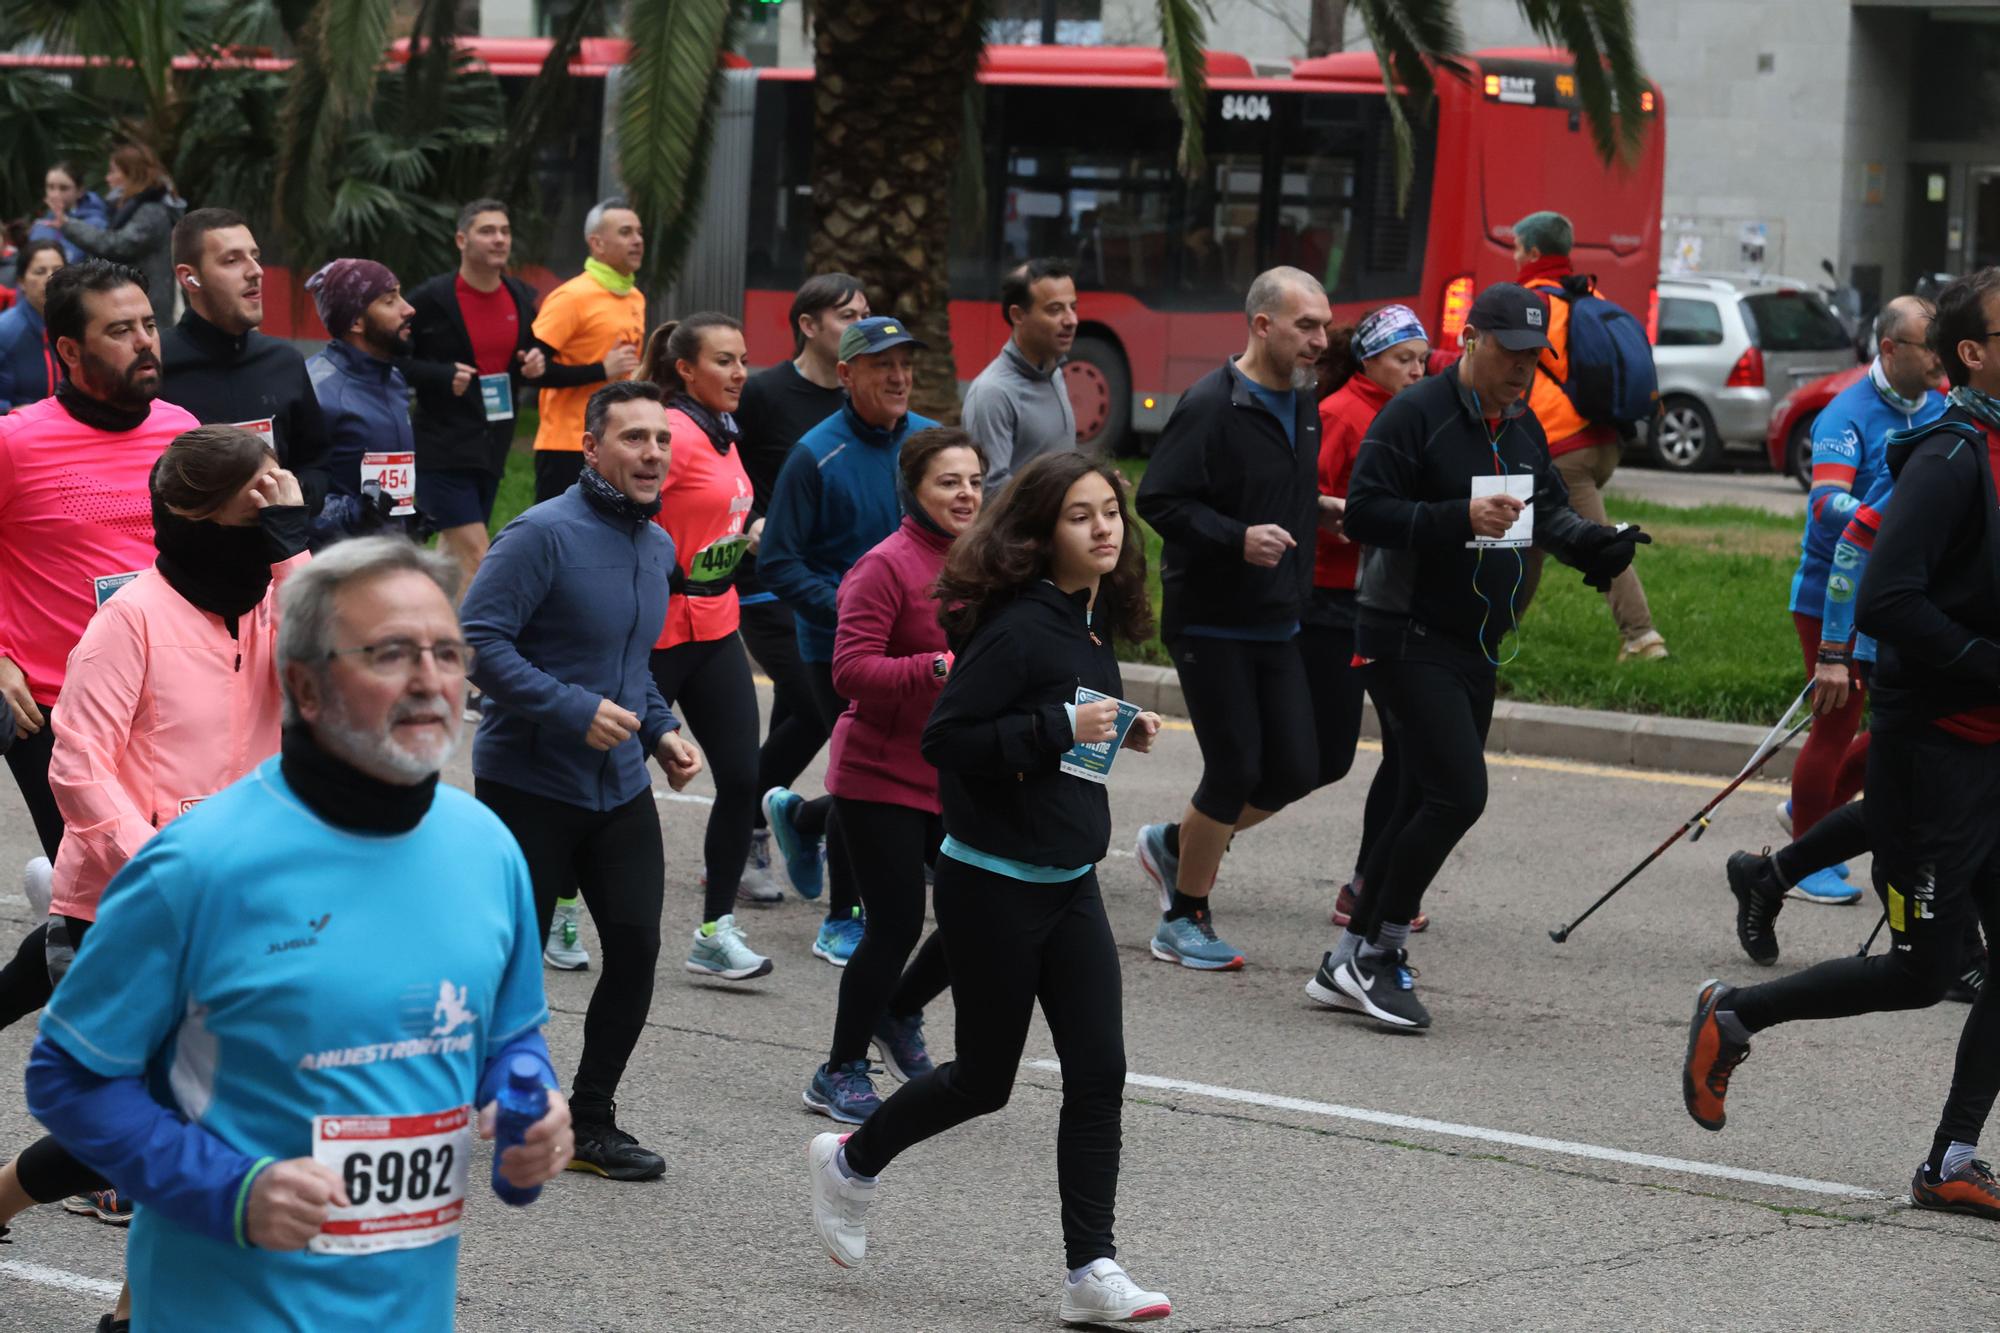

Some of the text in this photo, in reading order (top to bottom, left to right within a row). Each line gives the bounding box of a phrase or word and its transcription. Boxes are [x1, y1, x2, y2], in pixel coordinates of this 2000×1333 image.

[1221, 94, 1271, 121] 8404
[378, 468, 408, 489] 454
[701, 543, 739, 572] 4437
[343, 1143, 454, 1207] 6982
